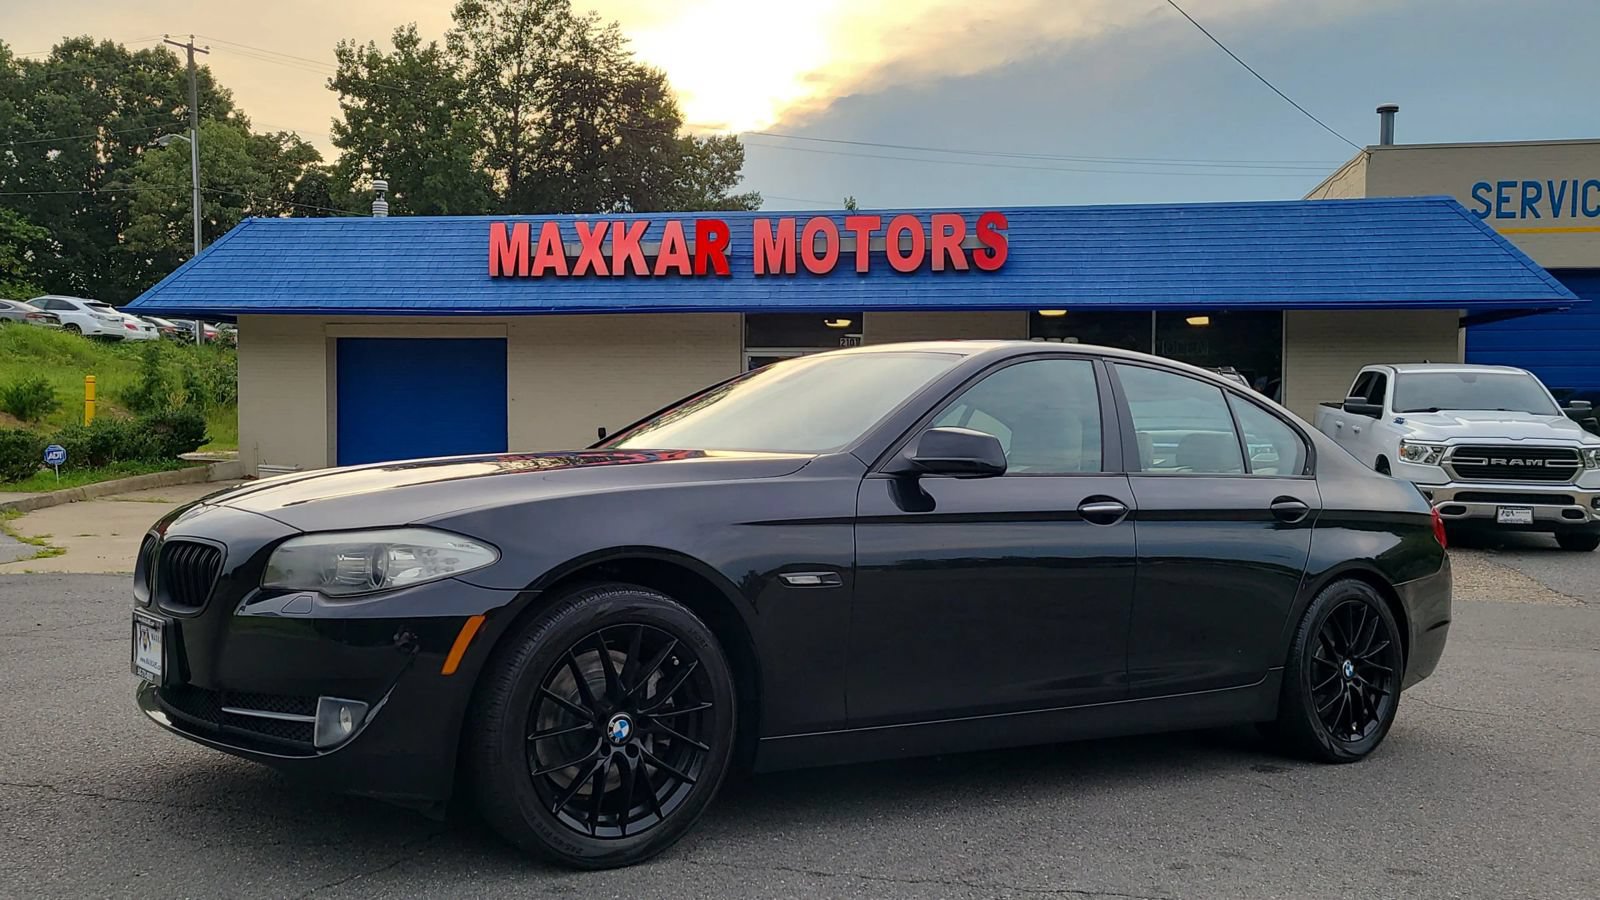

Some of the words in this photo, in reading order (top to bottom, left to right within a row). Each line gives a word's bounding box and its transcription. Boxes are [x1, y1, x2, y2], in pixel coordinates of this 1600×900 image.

[1471, 179, 1600, 219] SERVIC
[488, 219, 732, 277] MAXKAR
[753, 211, 1009, 275] MOTORS
[47, 450, 64, 460] ADT
[1490, 458, 1543, 466] RAM
